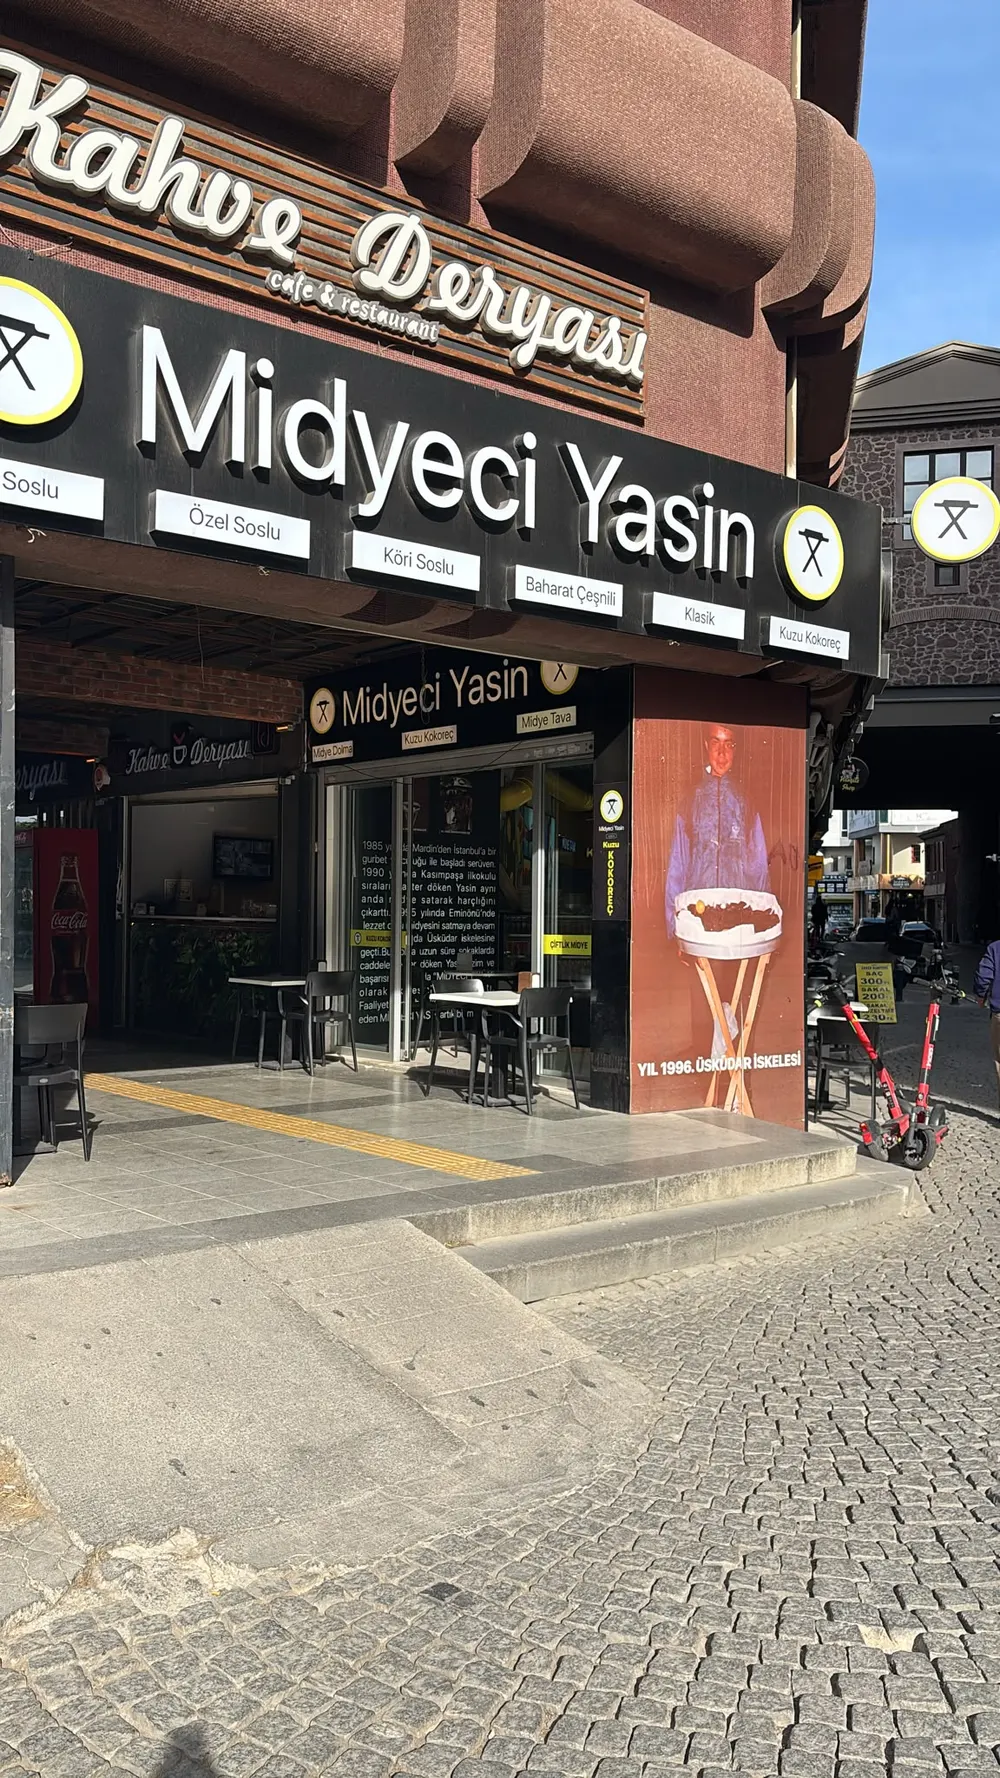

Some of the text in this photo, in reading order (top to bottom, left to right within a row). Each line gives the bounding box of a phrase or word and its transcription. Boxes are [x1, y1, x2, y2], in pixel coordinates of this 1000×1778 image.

[0, 49, 648, 382] Kahve Deryası
[269, 272, 314, 301] cafe
[342, 295, 439, 341] restaurant
[140, 324, 755, 579] Midyeci Yasin
[2, 471, 59, 499] Soslu
[189, 504, 281, 541] Özel Soslu
[383, 547, 455, 577] Köri Soslu
[526, 576, 616, 607] Baharat Çeşnili
[685, 606, 715, 626] Klasik
[779, 625, 841, 653] Kuzu Kokoreç
[343, 658, 528, 729] Midyeci Yasin
[521, 711, 571, 729] Midye Tava
[404, 728, 454, 746] Kuzu Kokoreç
[125, 737, 253, 775] Kahve Deryası
[313, 744, 353, 759] Midye Dolma
[15, 760, 67, 801] eryası
[361, 840, 383, 851] 1985
[487, 847, 497, 856] bir
[361, 854, 388, 866] gurbet
[362, 867, 385, 878] 1990
[421, 870, 464, 882] Kasımpaşa
[427, 883, 452, 893] döken
[455, 883, 477, 893] Yasin
[360, 894, 384, 904] anda
[421, 895, 453, 905] satarak
[420, 908, 446, 919] yılında
[419, 948, 438, 957] uzun
[420, 959, 443, 969] döken
[359, 987, 388, 997] olarak
[637, 1050, 801, 1077] YIL 1996. ÜSKÜDAR İSKELESİ
